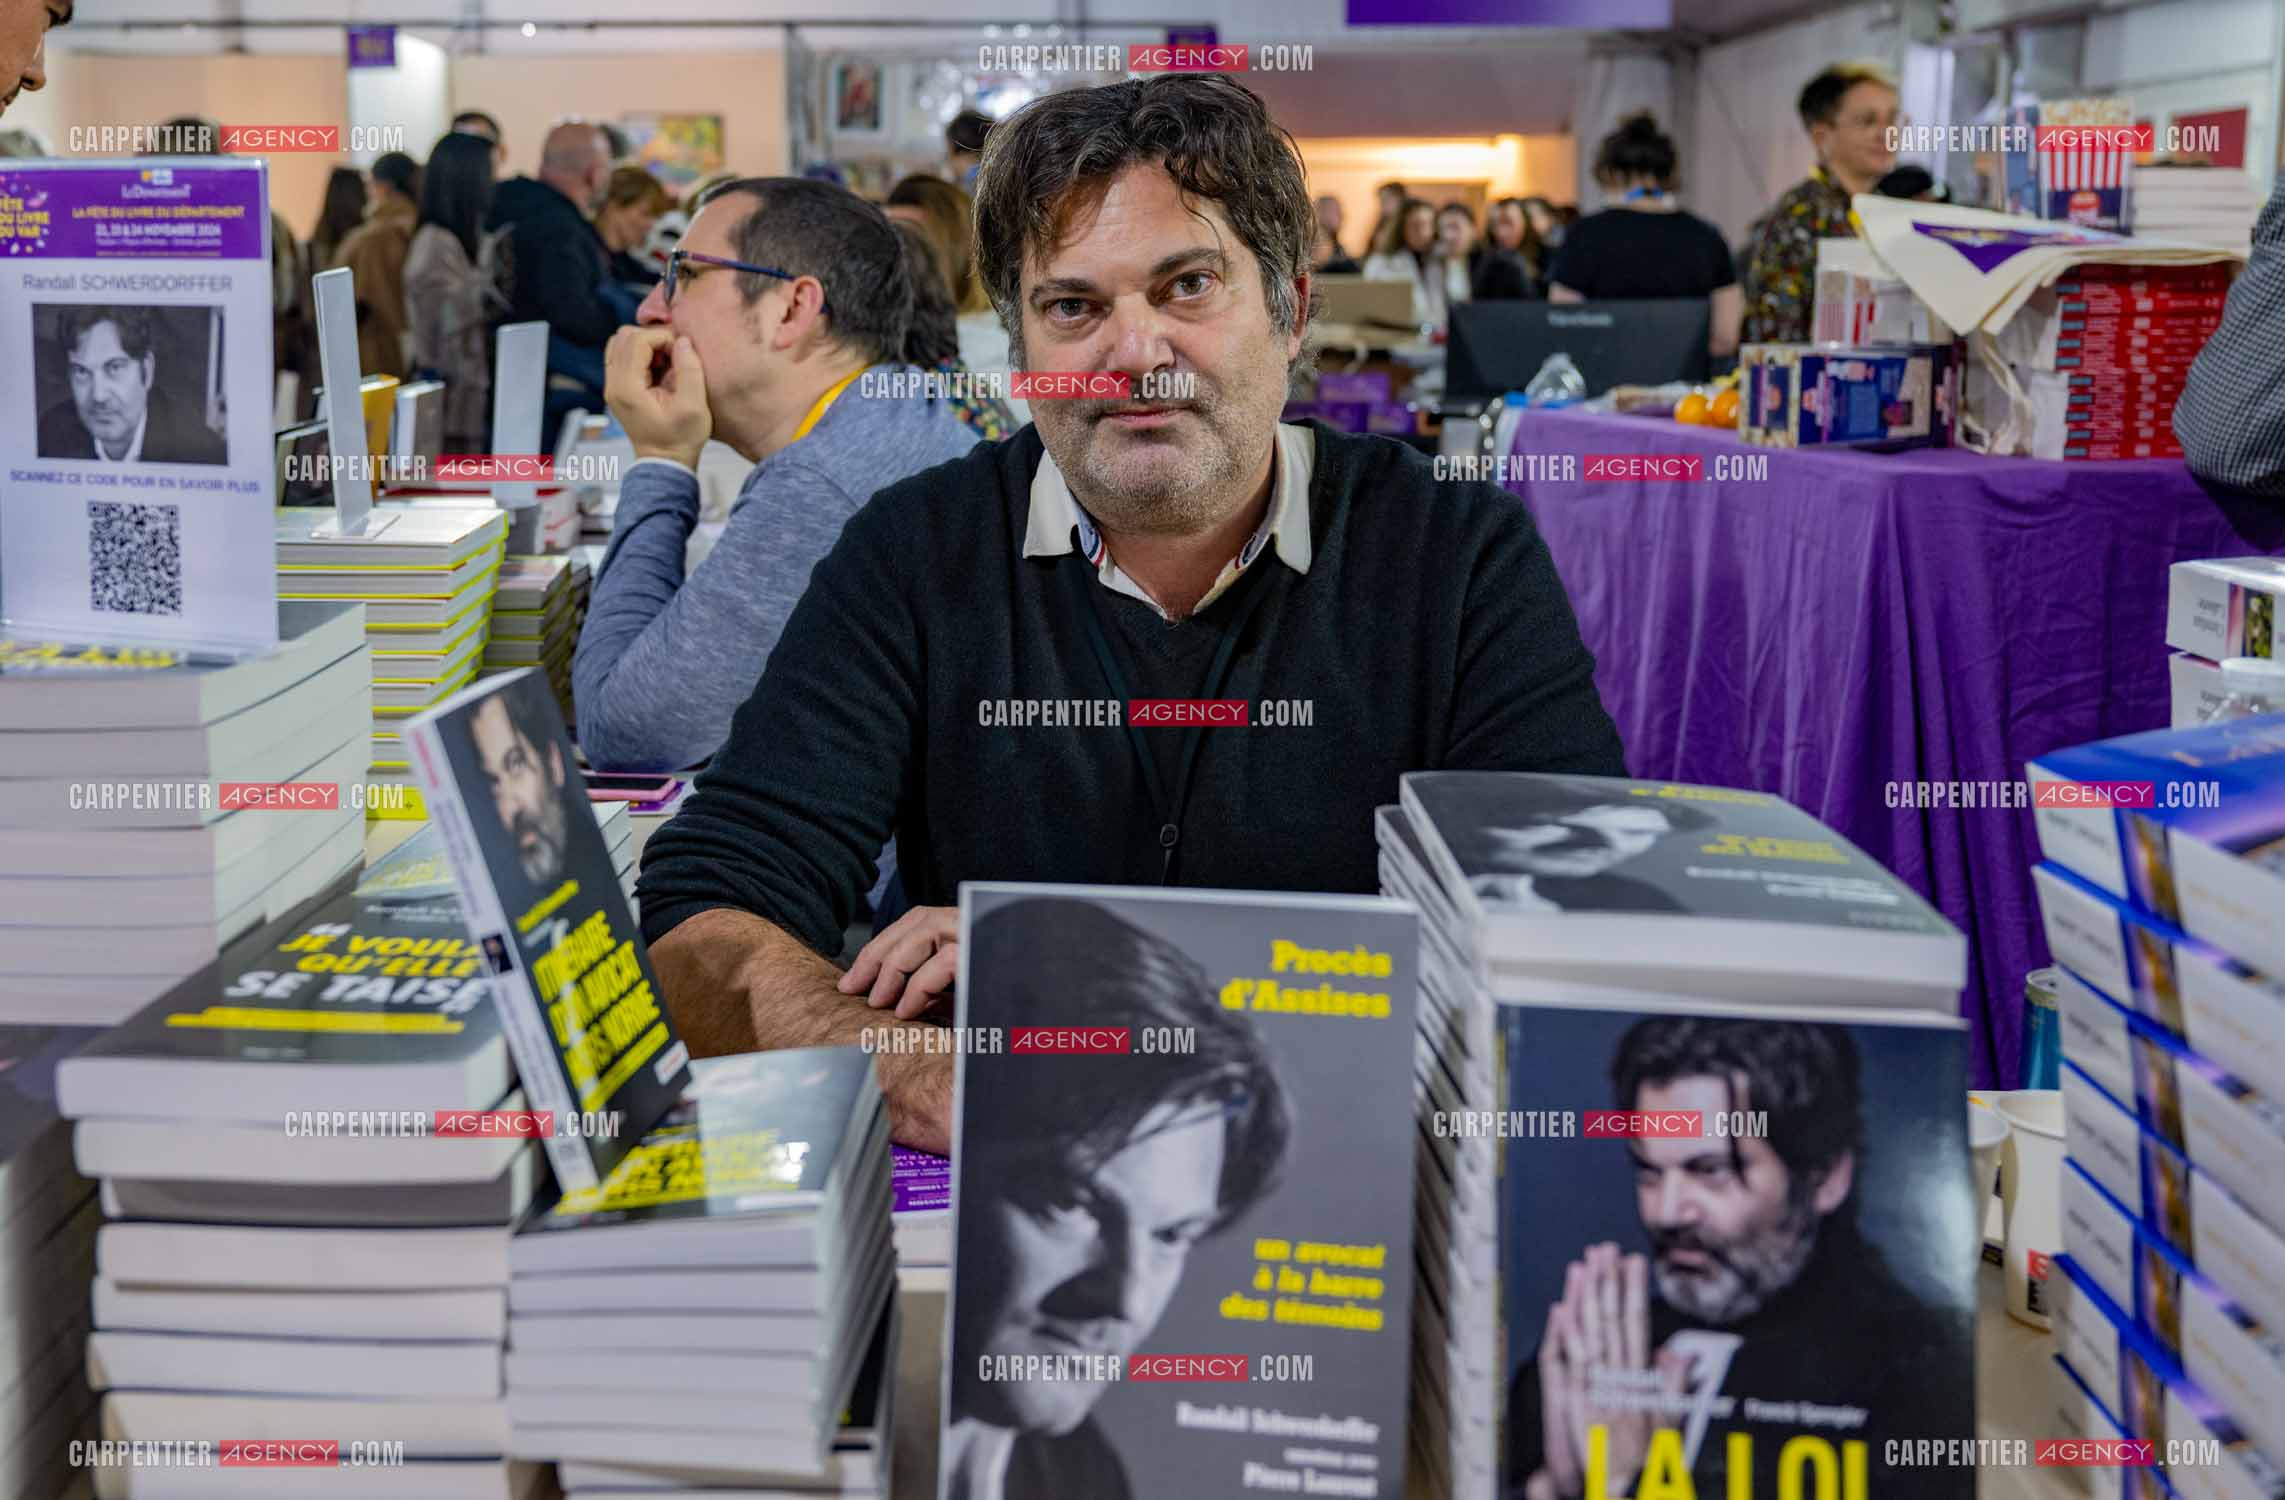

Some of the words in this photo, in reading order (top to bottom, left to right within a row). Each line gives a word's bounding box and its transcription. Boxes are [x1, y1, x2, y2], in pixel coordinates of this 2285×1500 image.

[23, 274, 75, 291] Randall
[87, 473, 118, 486] CODE
[122, 475, 155, 488] POUR
[228, 480, 261, 494] PLUS
[1271, 939, 1392, 978] Procès
[224, 970, 315, 999] SE
[1219, 977, 1391, 1019] d'Assises
